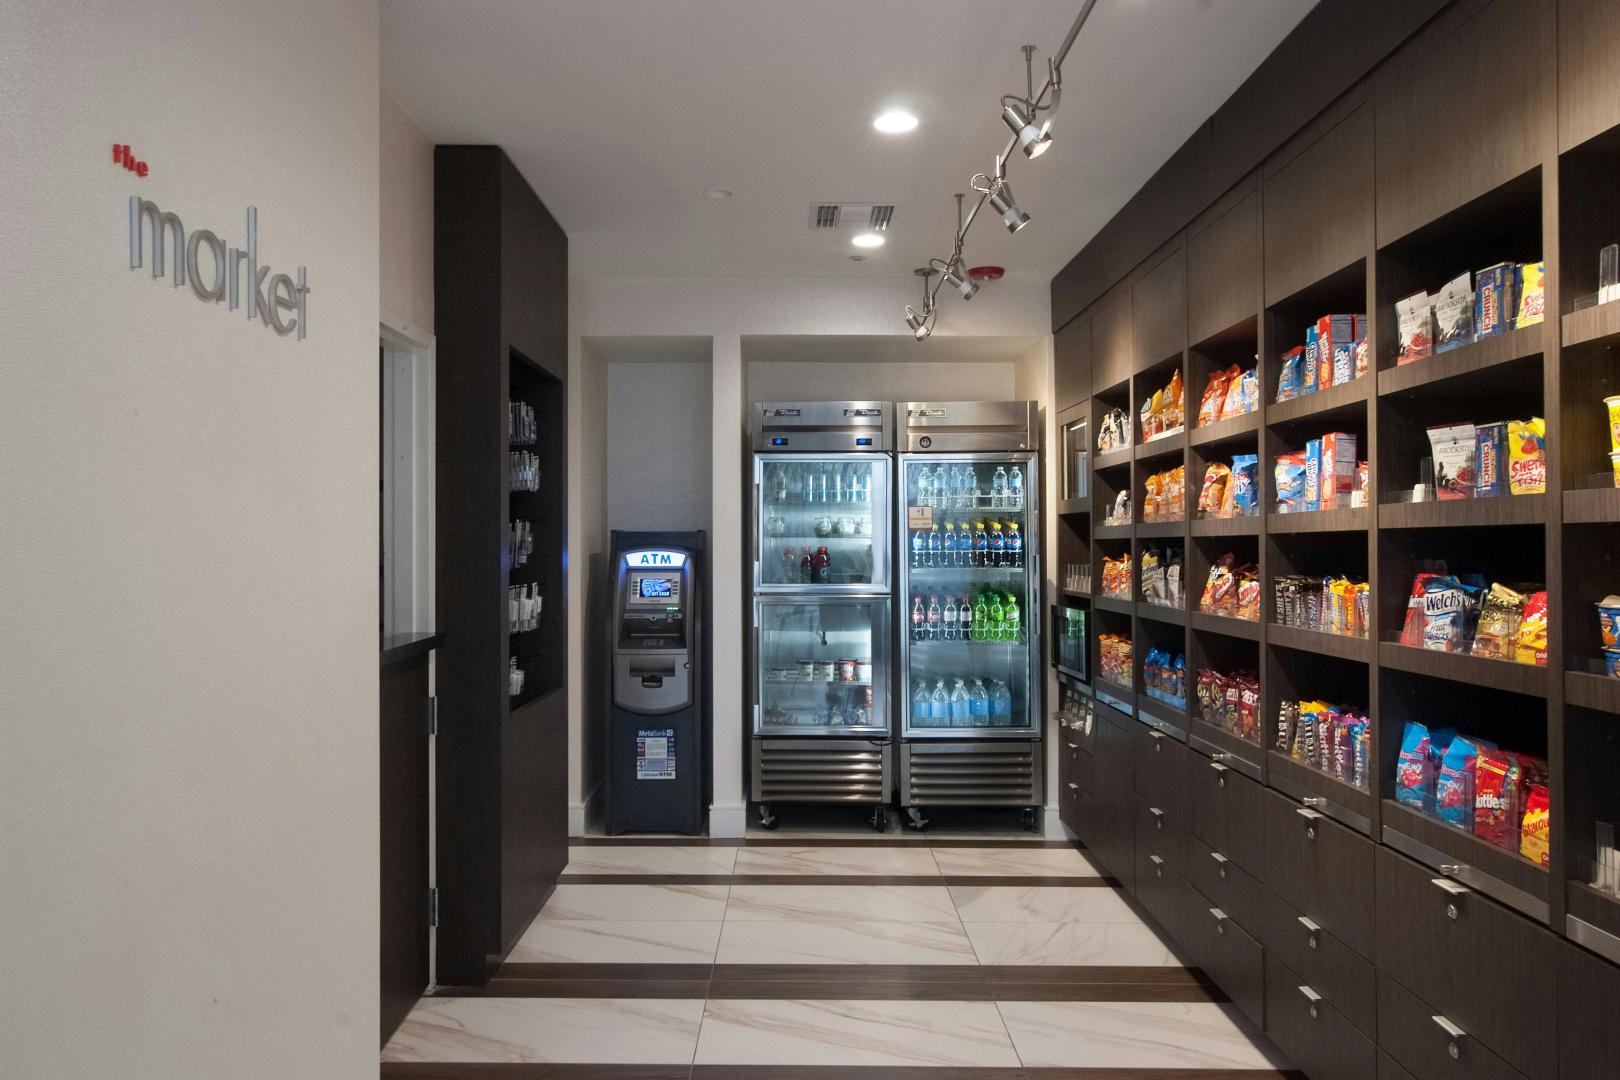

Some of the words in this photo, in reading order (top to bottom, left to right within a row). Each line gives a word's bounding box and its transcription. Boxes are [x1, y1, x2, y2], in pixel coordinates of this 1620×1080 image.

[113, 144, 148, 177] the
[130, 196, 311, 341] market
[1483, 287, 1491, 332] CRUNCH
[641, 554, 671, 564] ATM
[1276, 584, 1284, 625] ERSHEY'S
[1426, 591, 1461, 611] Welch's
[1475, 794, 1509, 811] kittles
